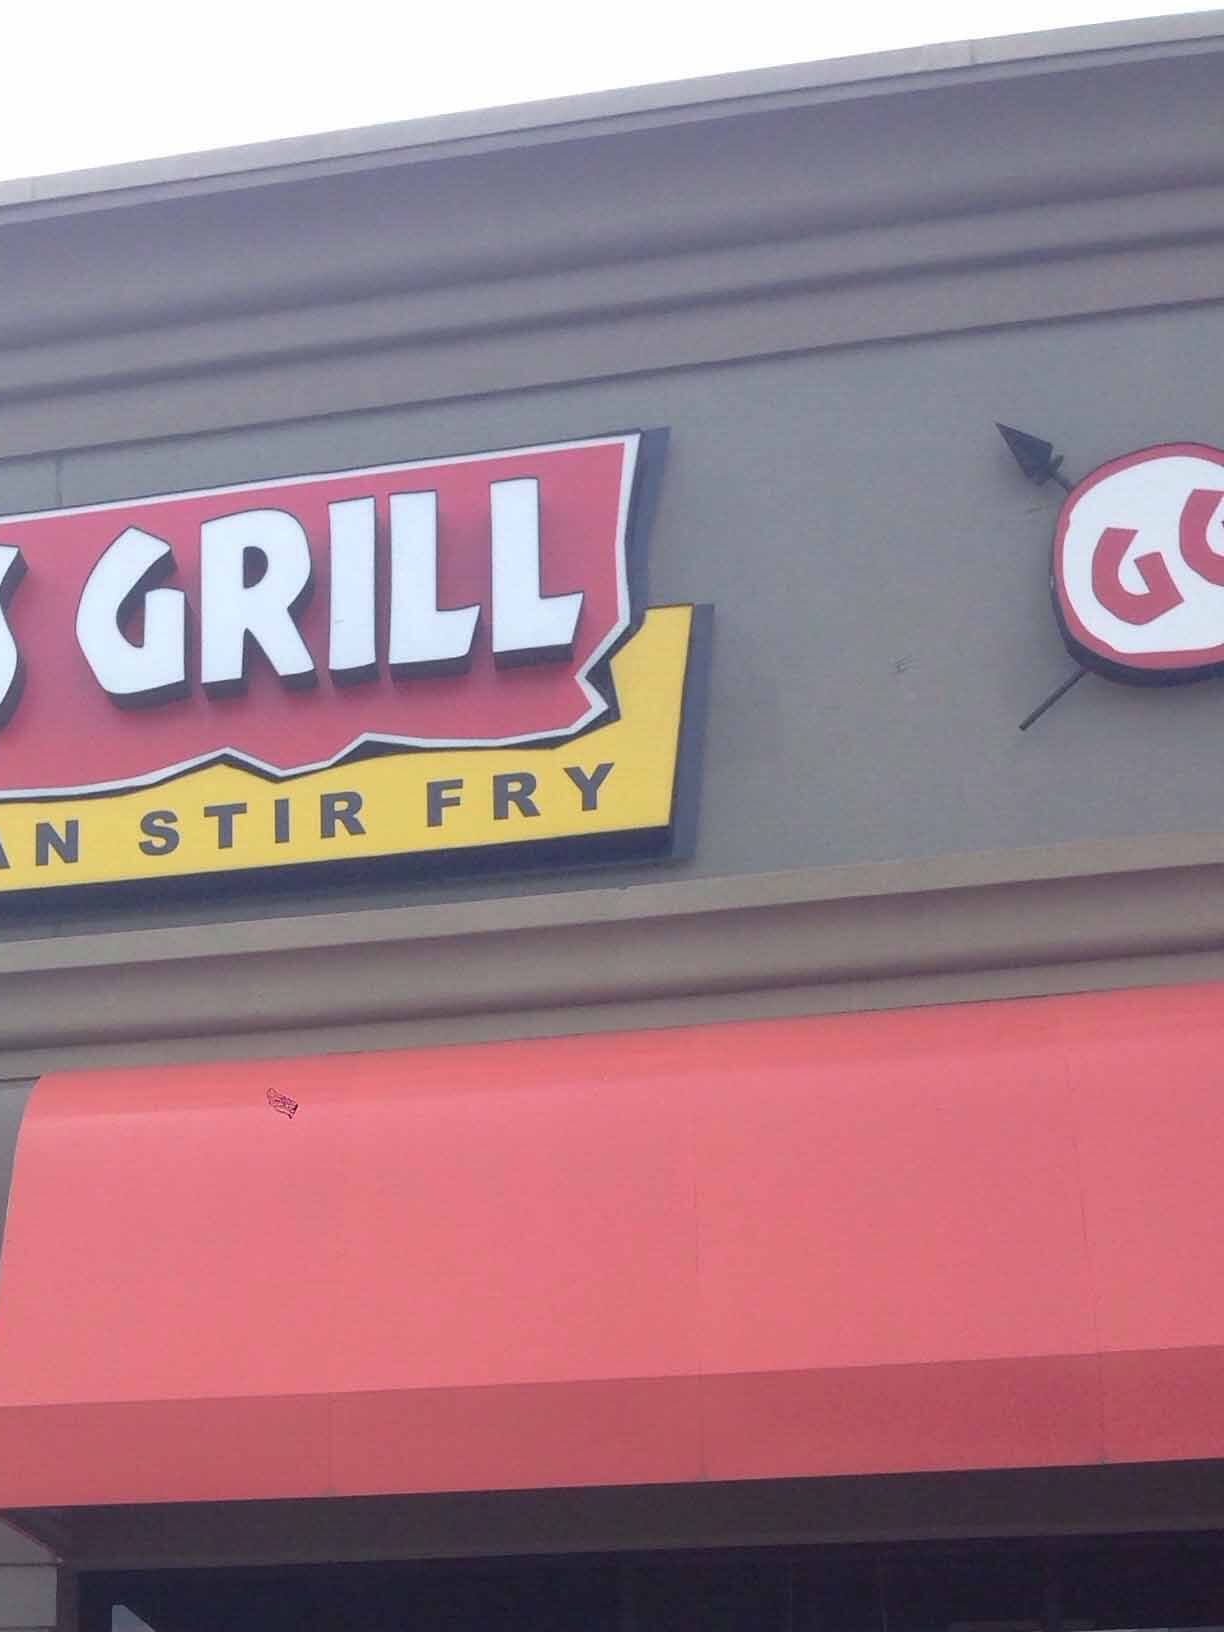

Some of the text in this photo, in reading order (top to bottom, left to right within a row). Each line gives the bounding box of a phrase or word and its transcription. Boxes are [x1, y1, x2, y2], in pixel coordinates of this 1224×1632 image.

[76, 477, 584, 695] GRILL
[137, 791, 367, 856] STIR
[426, 762, 616, 828] FRY
